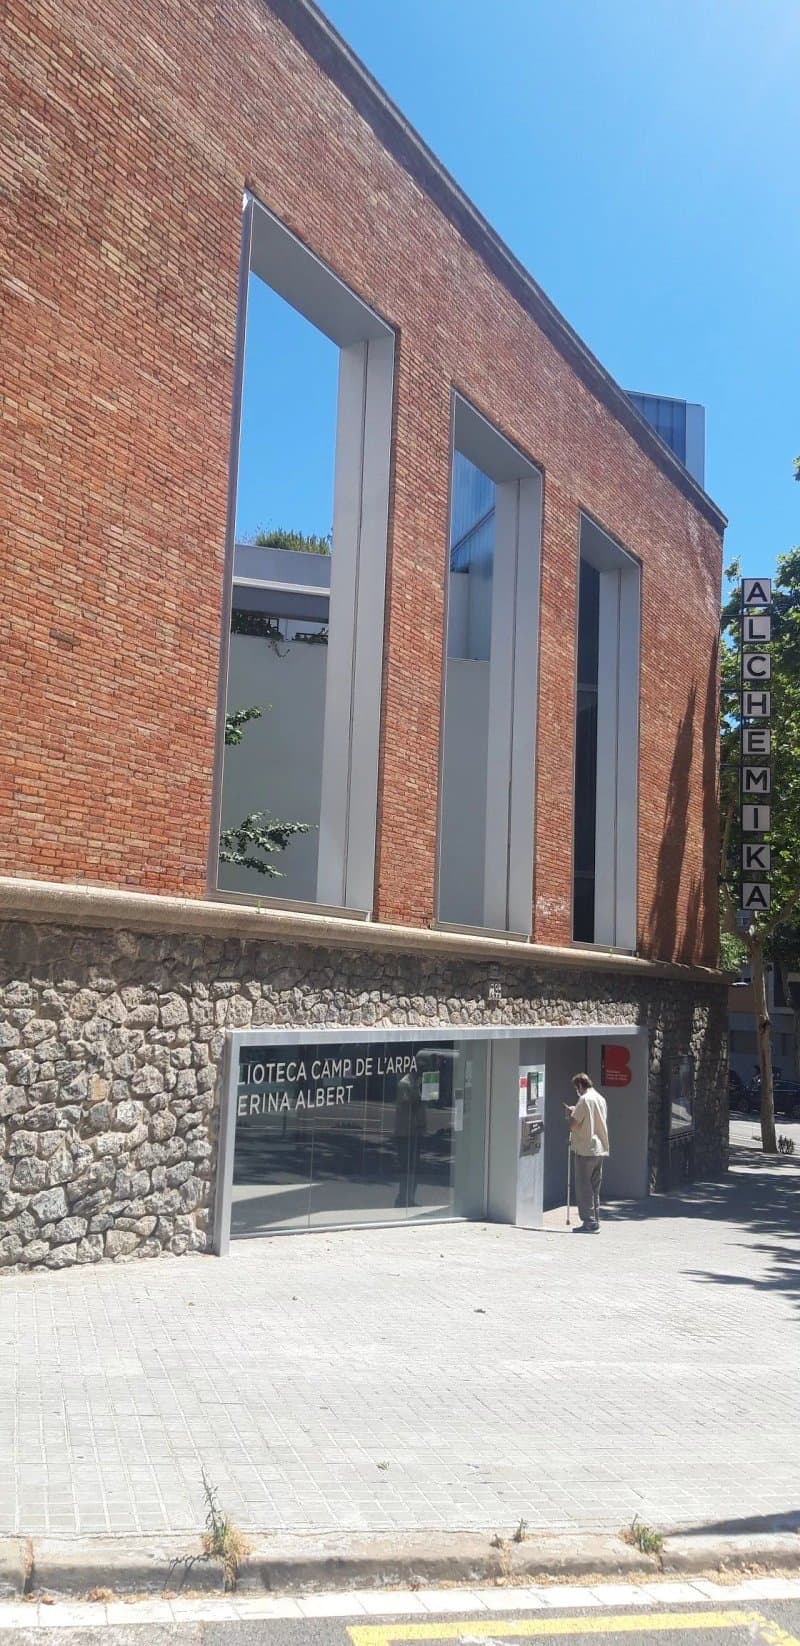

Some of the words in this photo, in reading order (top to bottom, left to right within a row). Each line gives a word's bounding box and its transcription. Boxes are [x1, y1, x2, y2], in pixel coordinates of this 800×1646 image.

[745, 581, 769, 908] ALCHEMIKA
[311, 1059, 351, 1081] CAMP
[355, 1057, 373, 1077] DE
[377, 1056, 418, 1075] L'ARPA
[237, 1092, 291, 1117] ERINA
[295, 1085, 354, 1110] ALBERT
